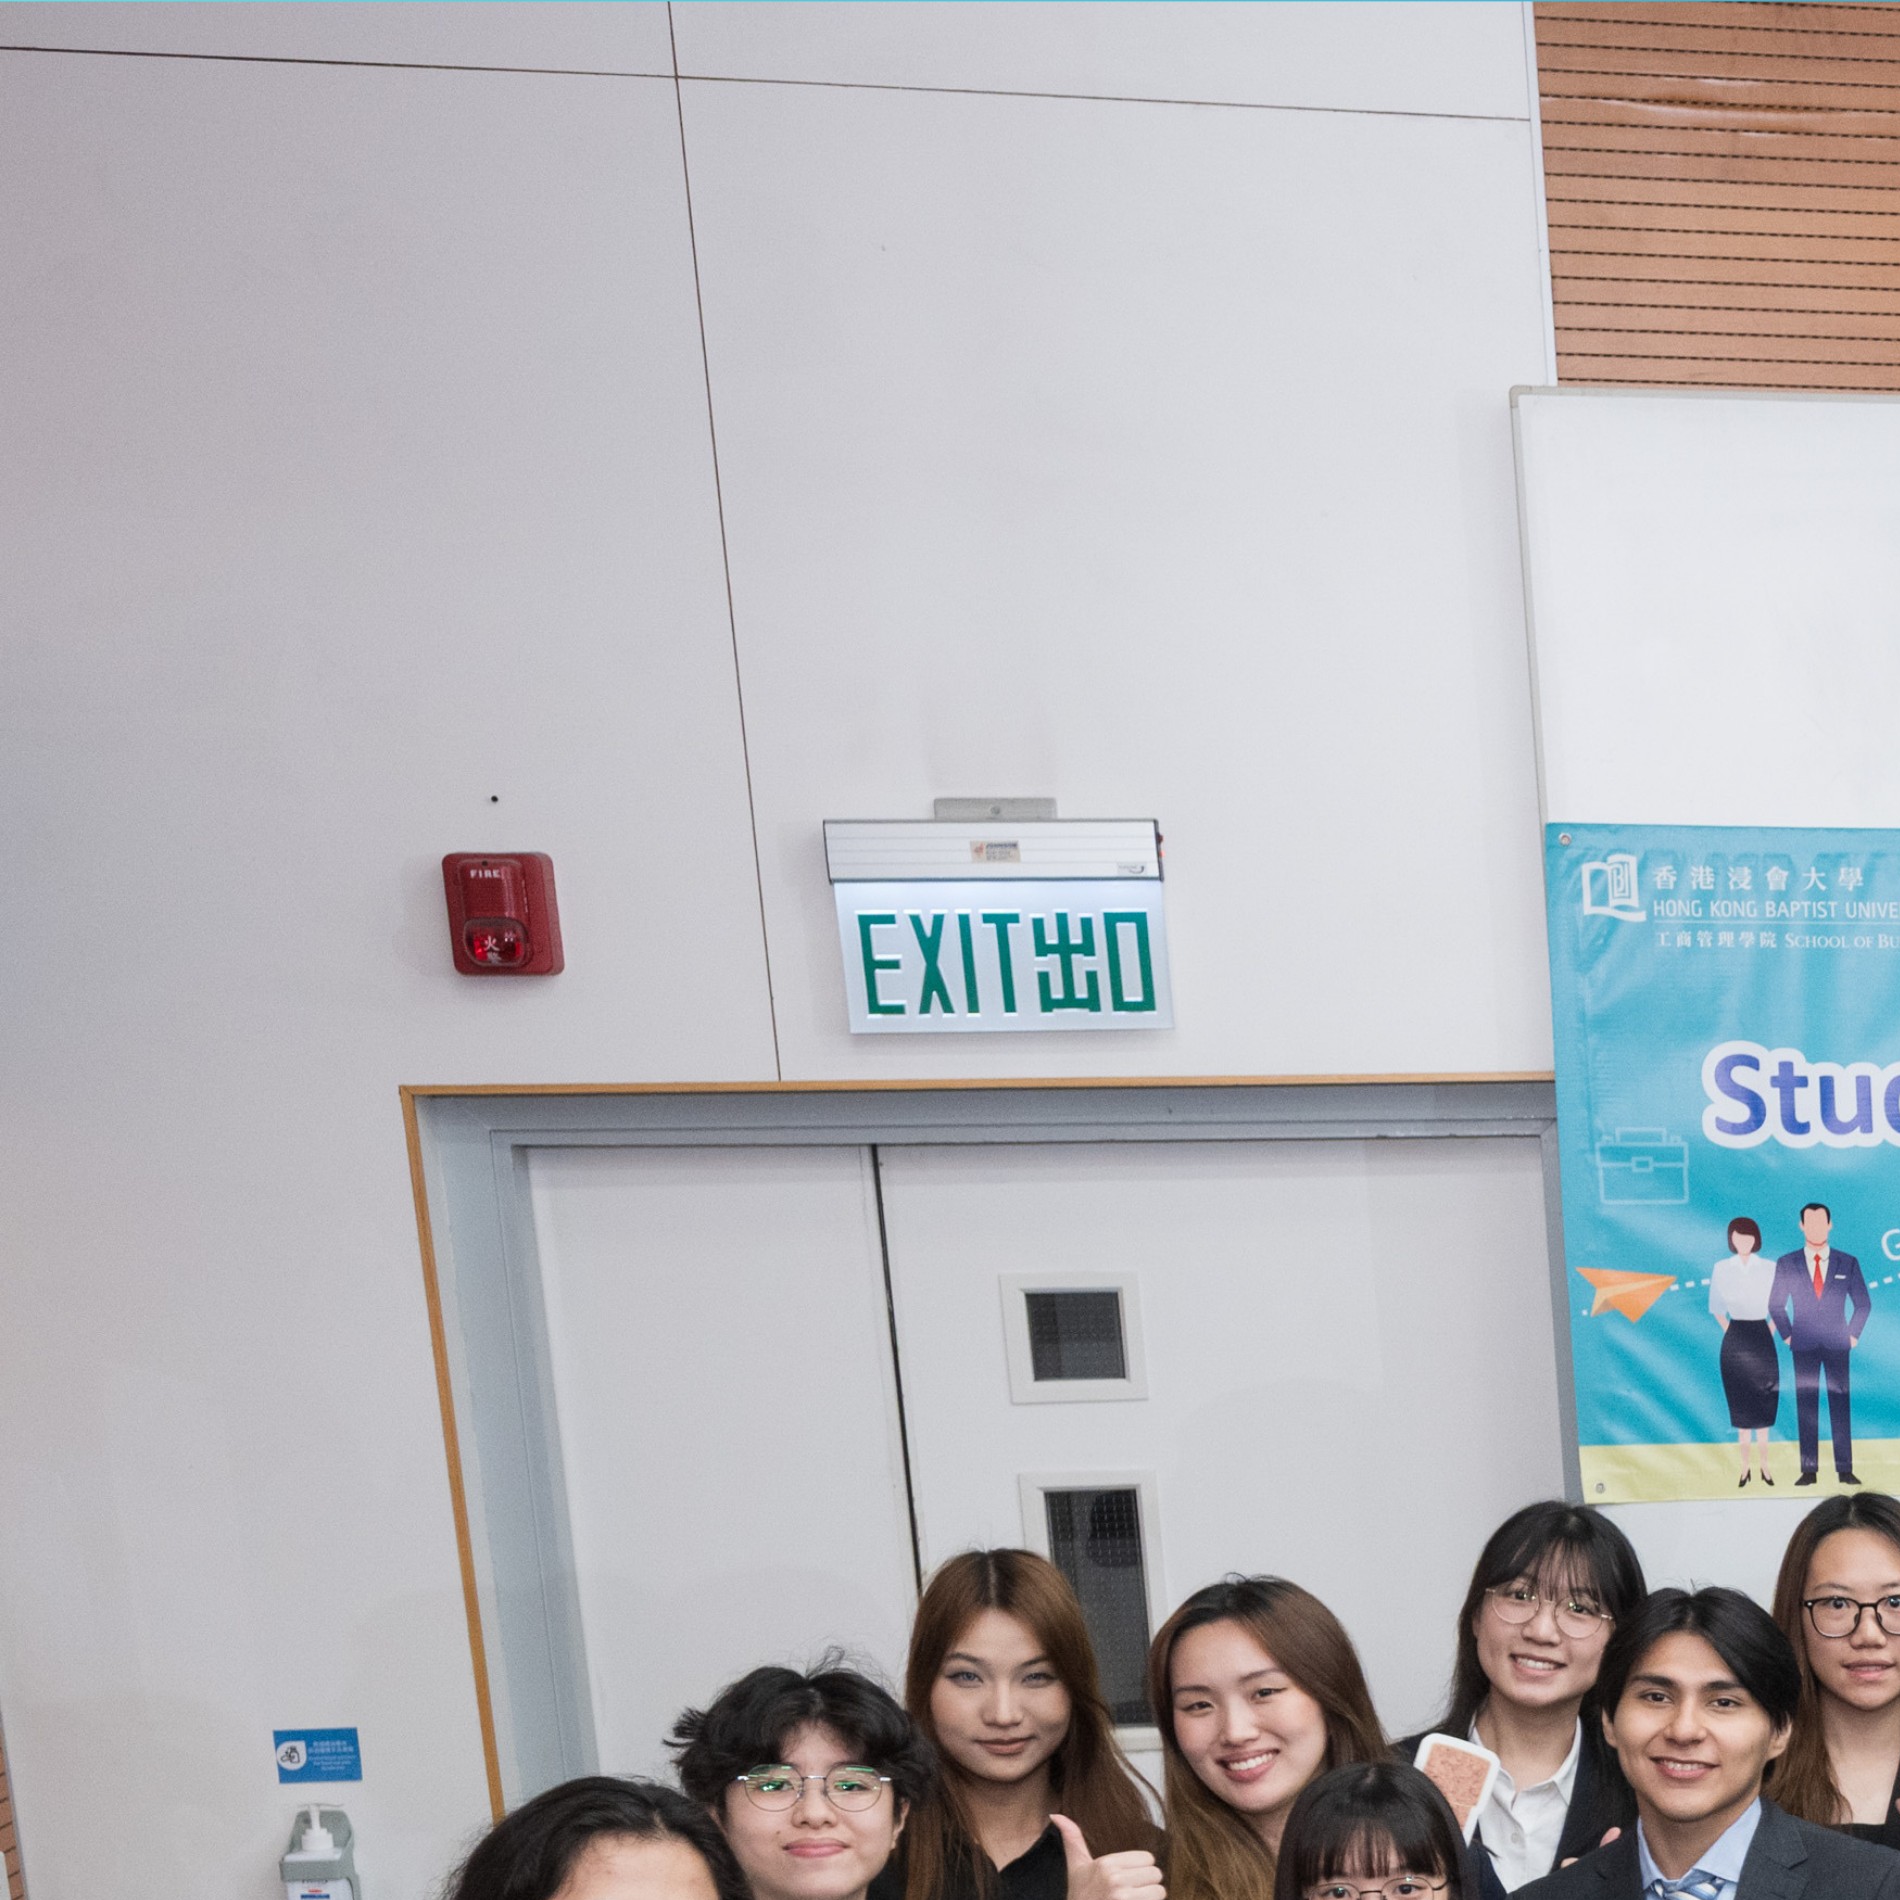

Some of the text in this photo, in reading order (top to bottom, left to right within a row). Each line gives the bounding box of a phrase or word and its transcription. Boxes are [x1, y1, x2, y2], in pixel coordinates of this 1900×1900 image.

[469, 869, 500, 879] FIRE
[1652, 865, 1865, 892] 香港浸會大學
[1653, 900, 1703, 919] HONG
[1710, 900, 1757, 919] KONG
[1765, 901, 1838, 919] BAPTIST
[1656, 931, 1778, 949] 工商管理學院
[857, 910, 1157, 1016] EXIT 出口
